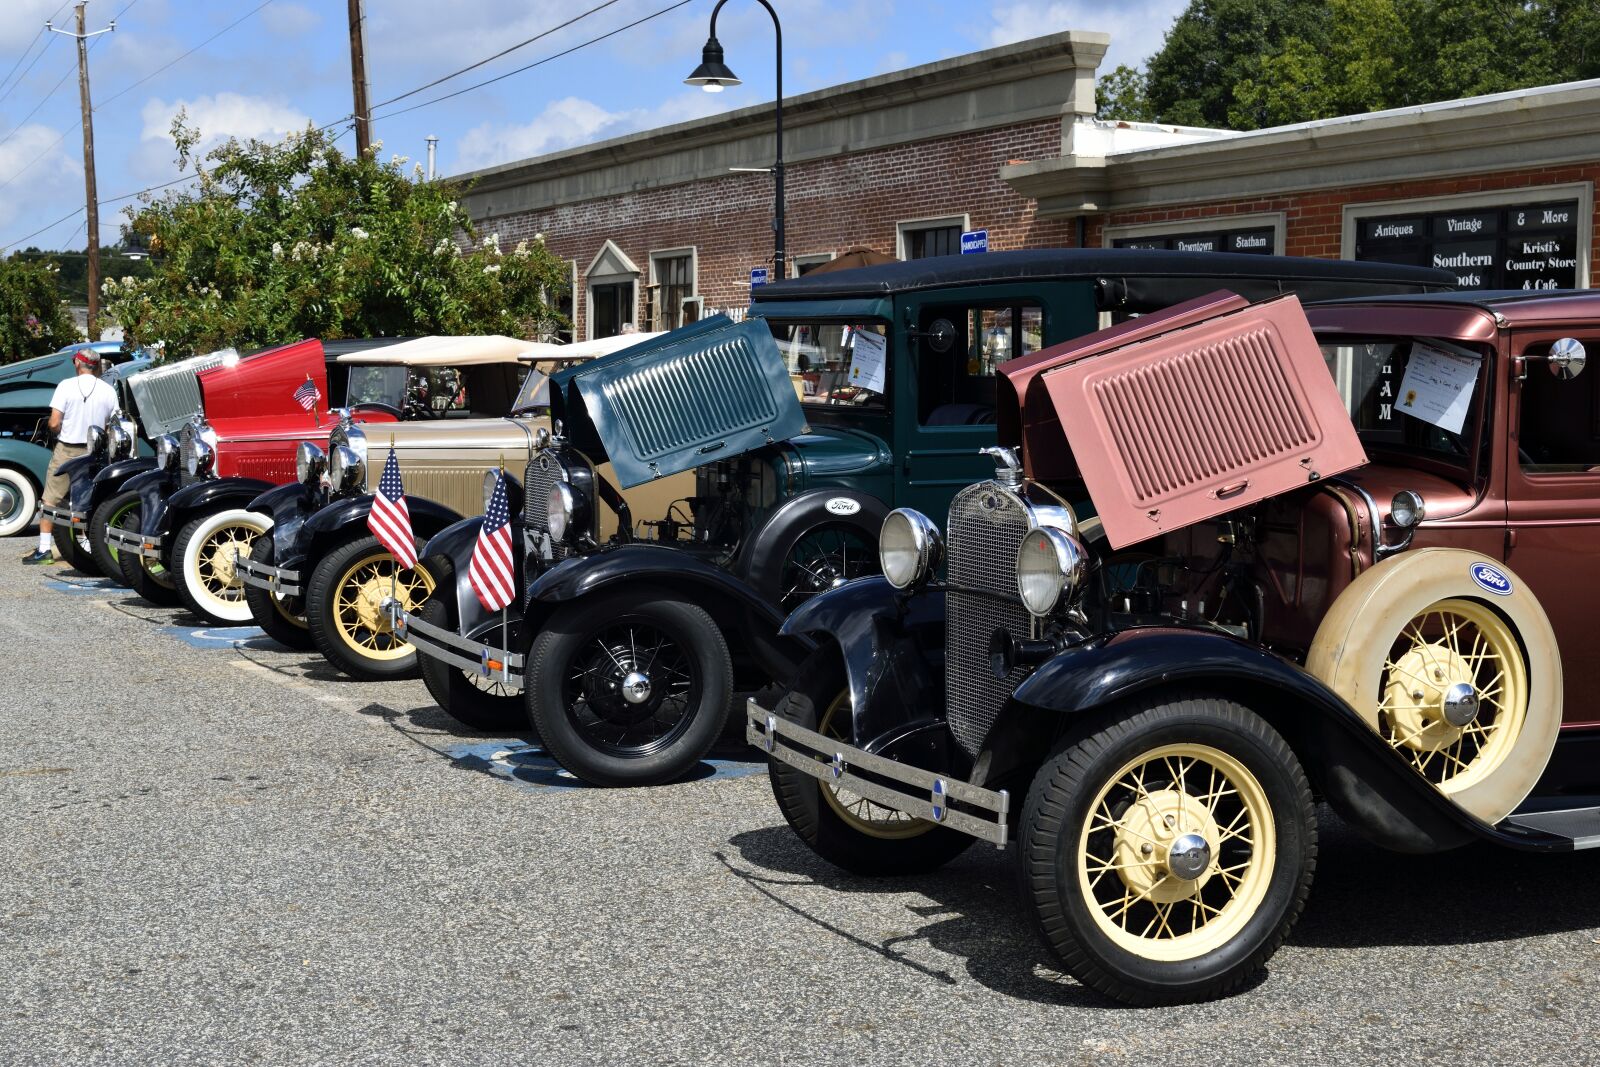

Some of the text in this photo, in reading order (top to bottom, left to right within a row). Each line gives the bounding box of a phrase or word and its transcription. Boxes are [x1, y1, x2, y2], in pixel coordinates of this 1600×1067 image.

[1374, 211, 1568, 238] Antiques Vintage & More
[1236, 236, 1266, 248] Statham
[1523, 241, 1560, 254] Kristi's
[1433, 252, 1492, 269] Southern
[1506, 256, 1576, 272] Country Store
[1456, 274, 1481, 287] oots
[831, 500, 855, 511] Ford
[1478, 568, 1506, 588] Ford
